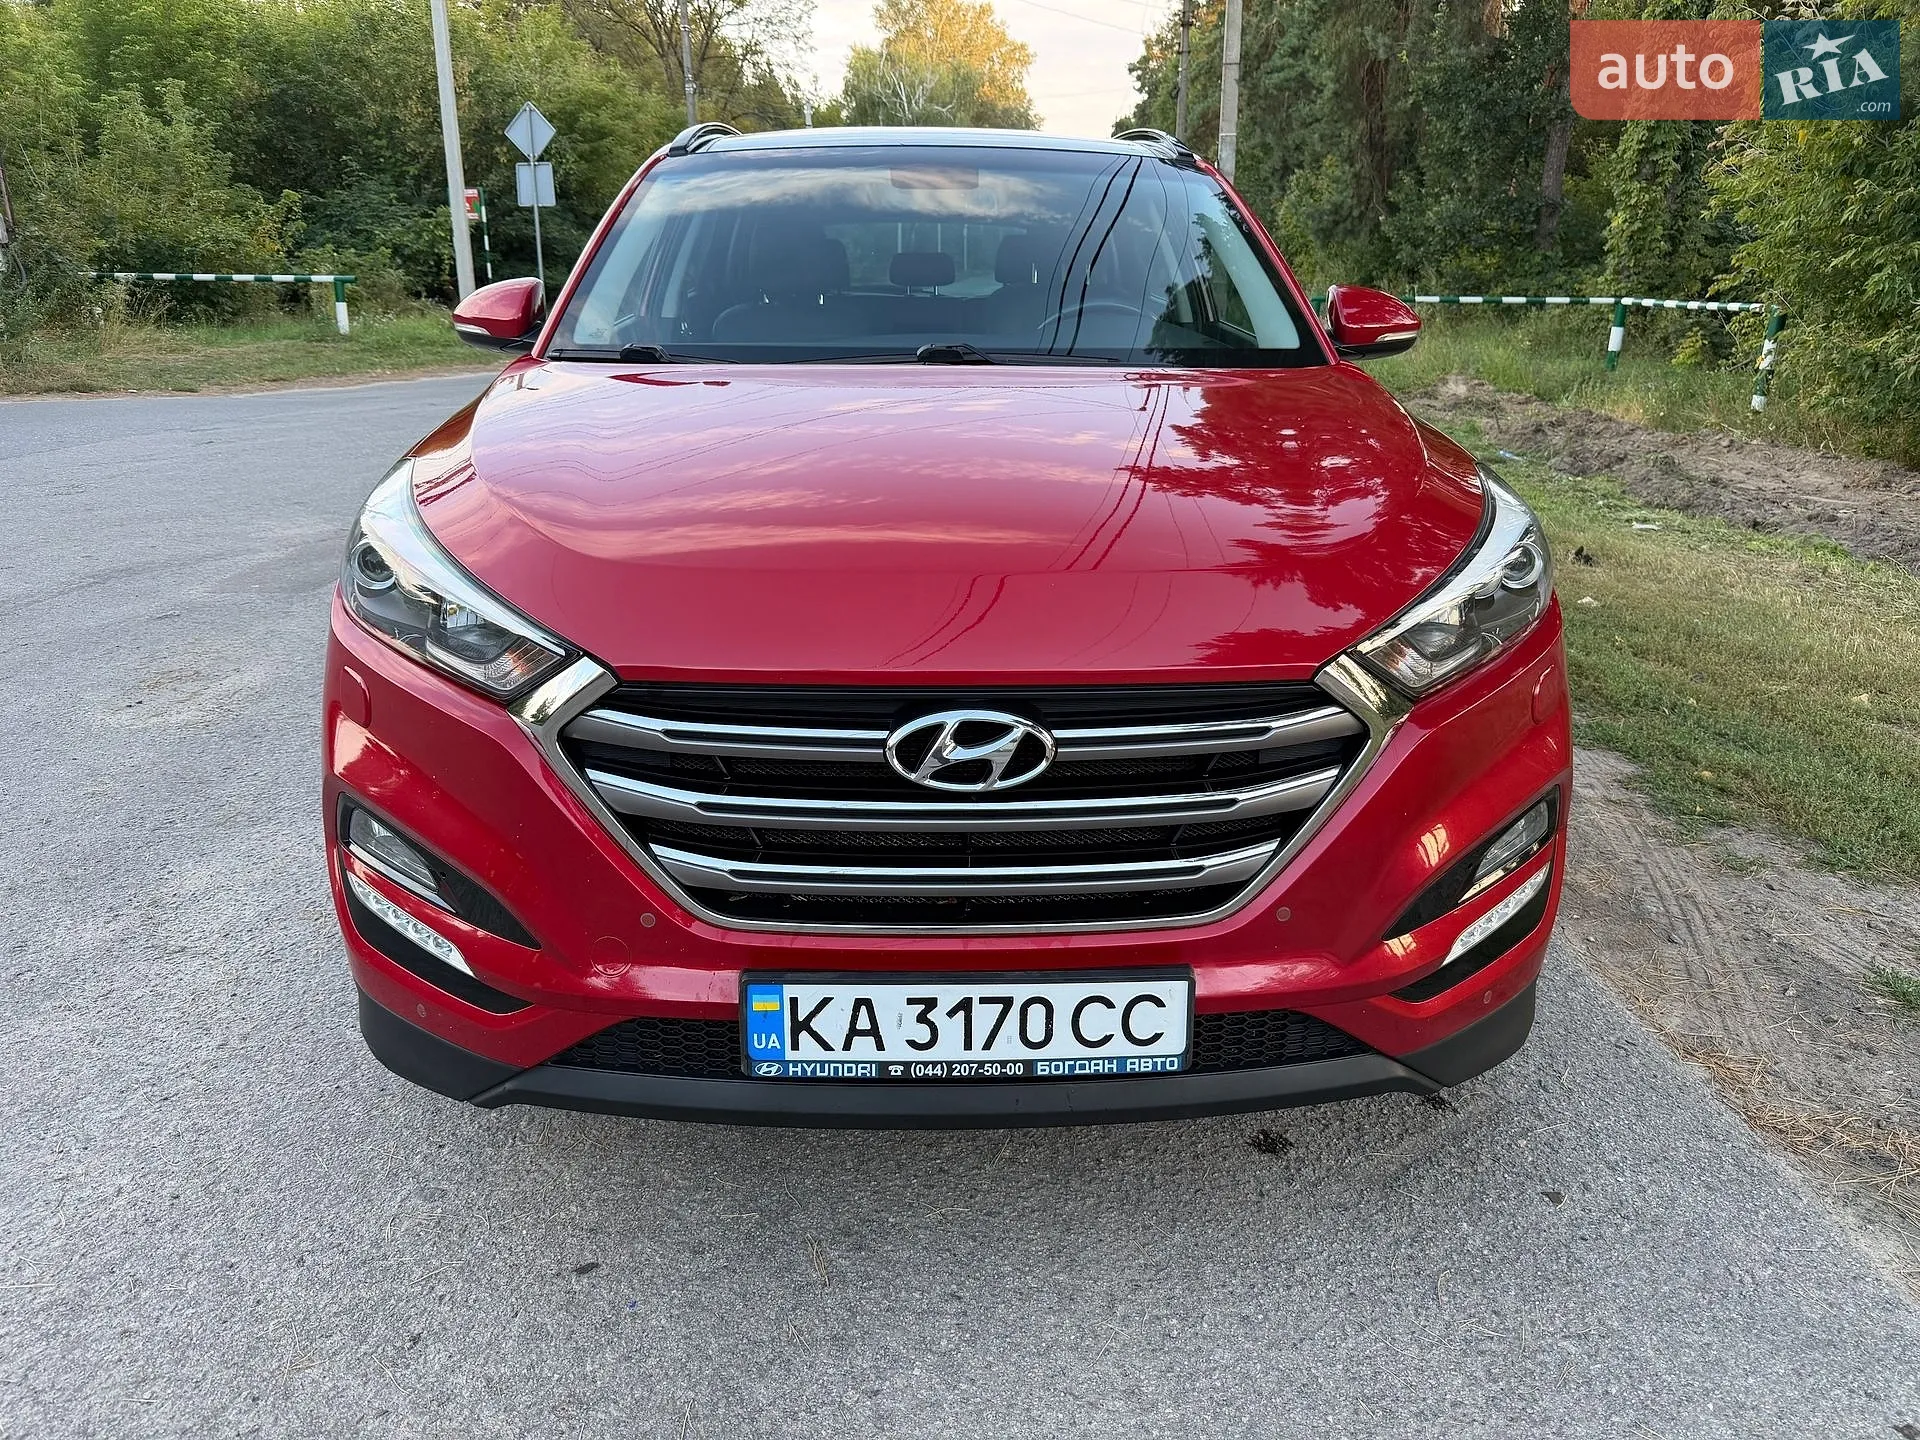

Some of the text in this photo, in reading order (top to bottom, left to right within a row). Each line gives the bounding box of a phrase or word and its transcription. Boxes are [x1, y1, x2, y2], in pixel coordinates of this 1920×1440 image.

[788, 993, 1166, 1052] KA 3170 CC
[753, 1034, 781, 1049] UA
[788, 1062, 1024, 1078] HYUNDAI (044) 207-50-00
[1036, 1057, 1178, 1076] БОГДАН АВТО
